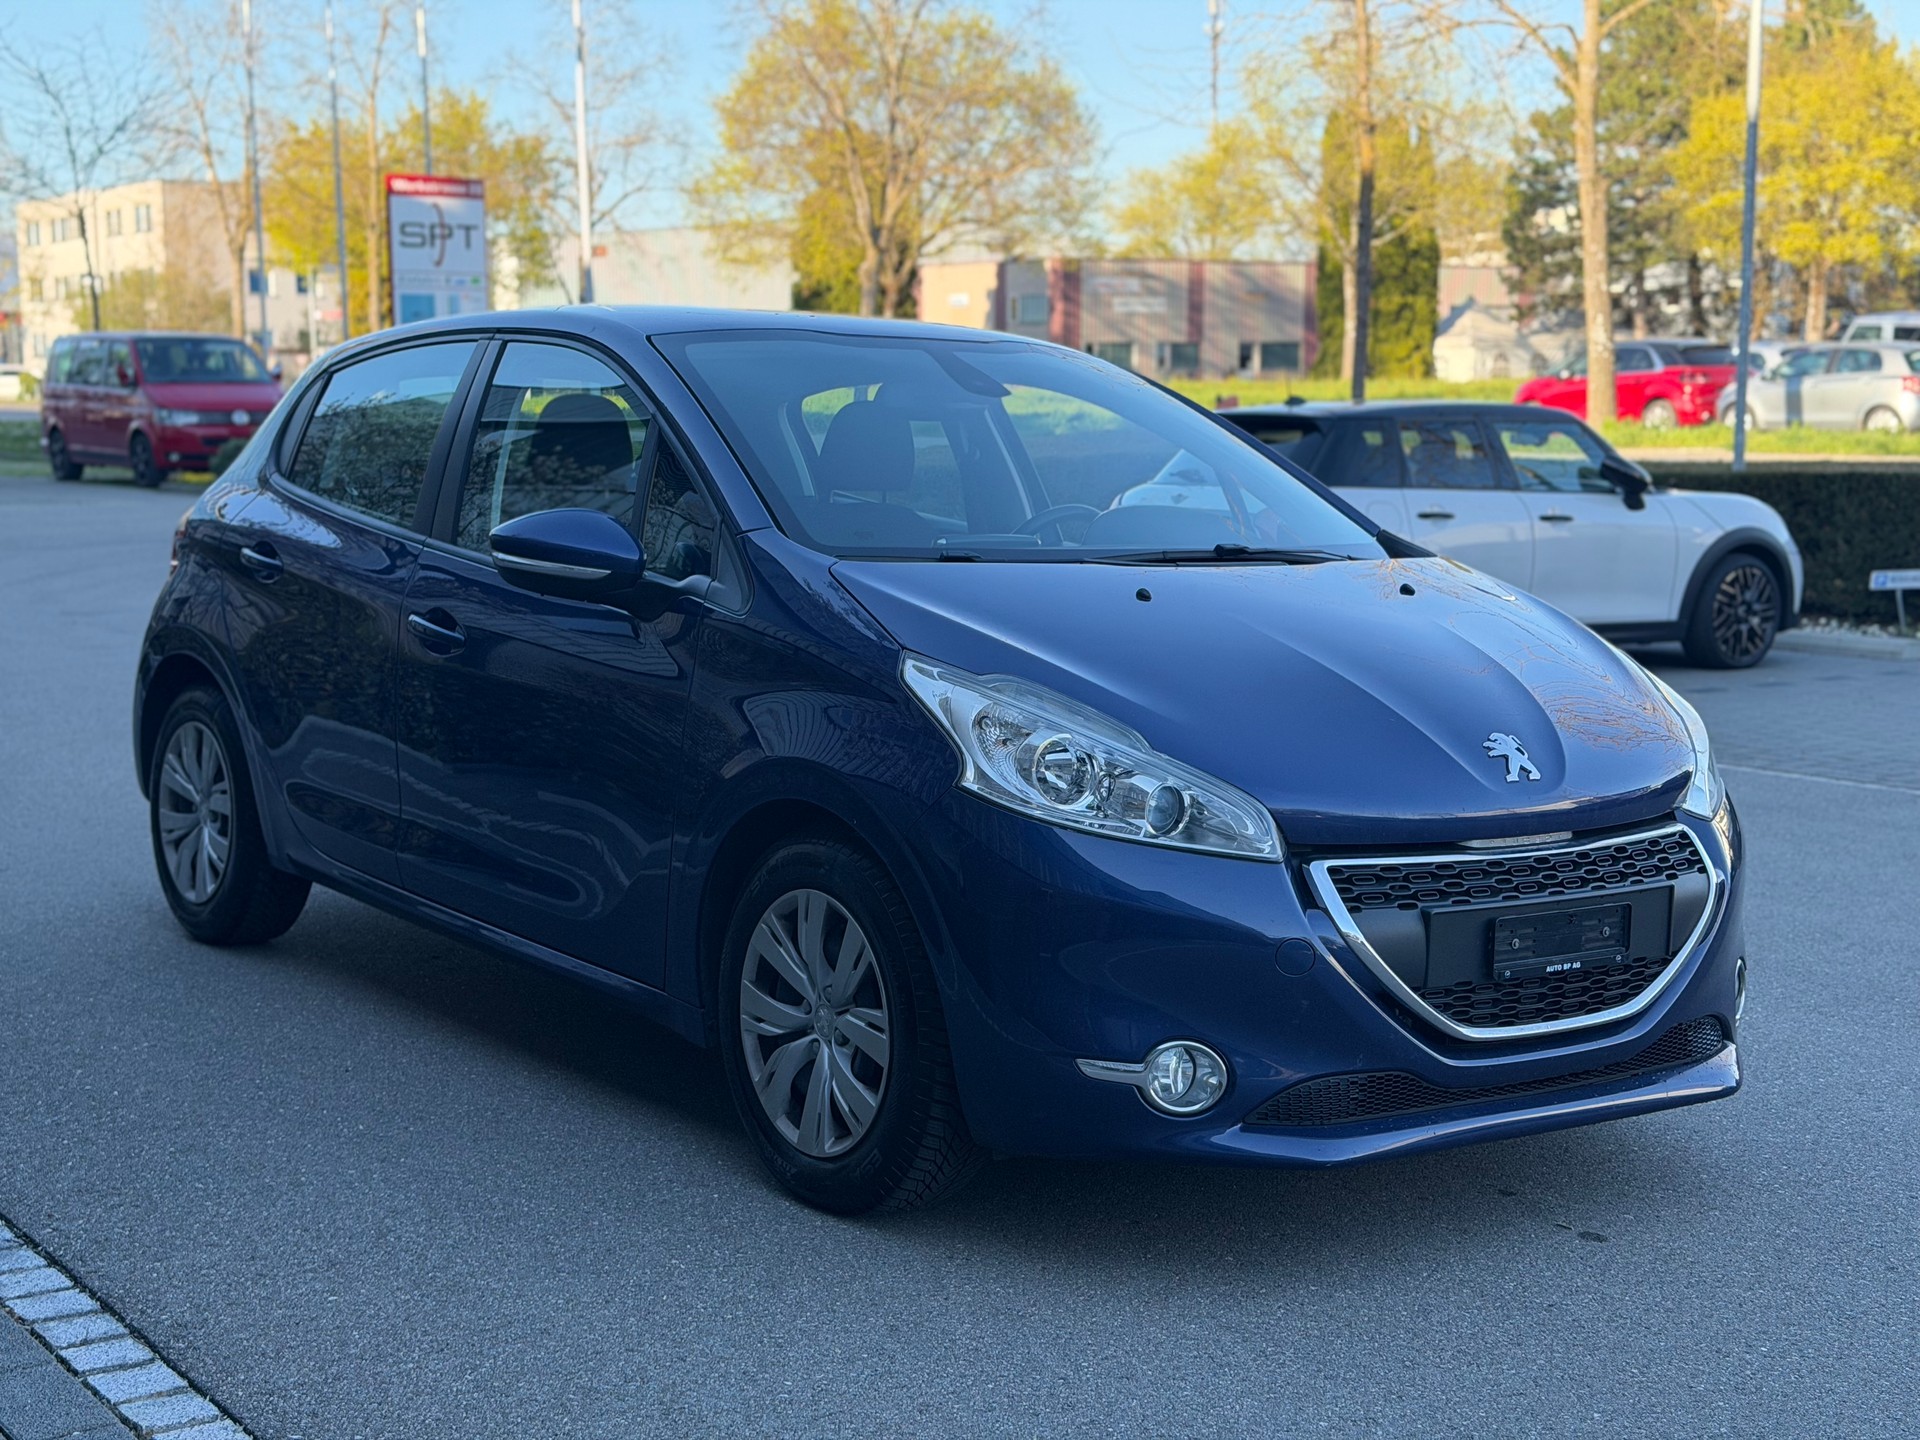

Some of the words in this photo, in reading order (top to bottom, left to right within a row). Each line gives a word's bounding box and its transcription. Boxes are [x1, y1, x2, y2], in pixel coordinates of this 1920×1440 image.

[399, 221, 479, 249] SPT
[1546, 964, 1562, 972] AUTO
[1572, 961, 1581, 969] AG
